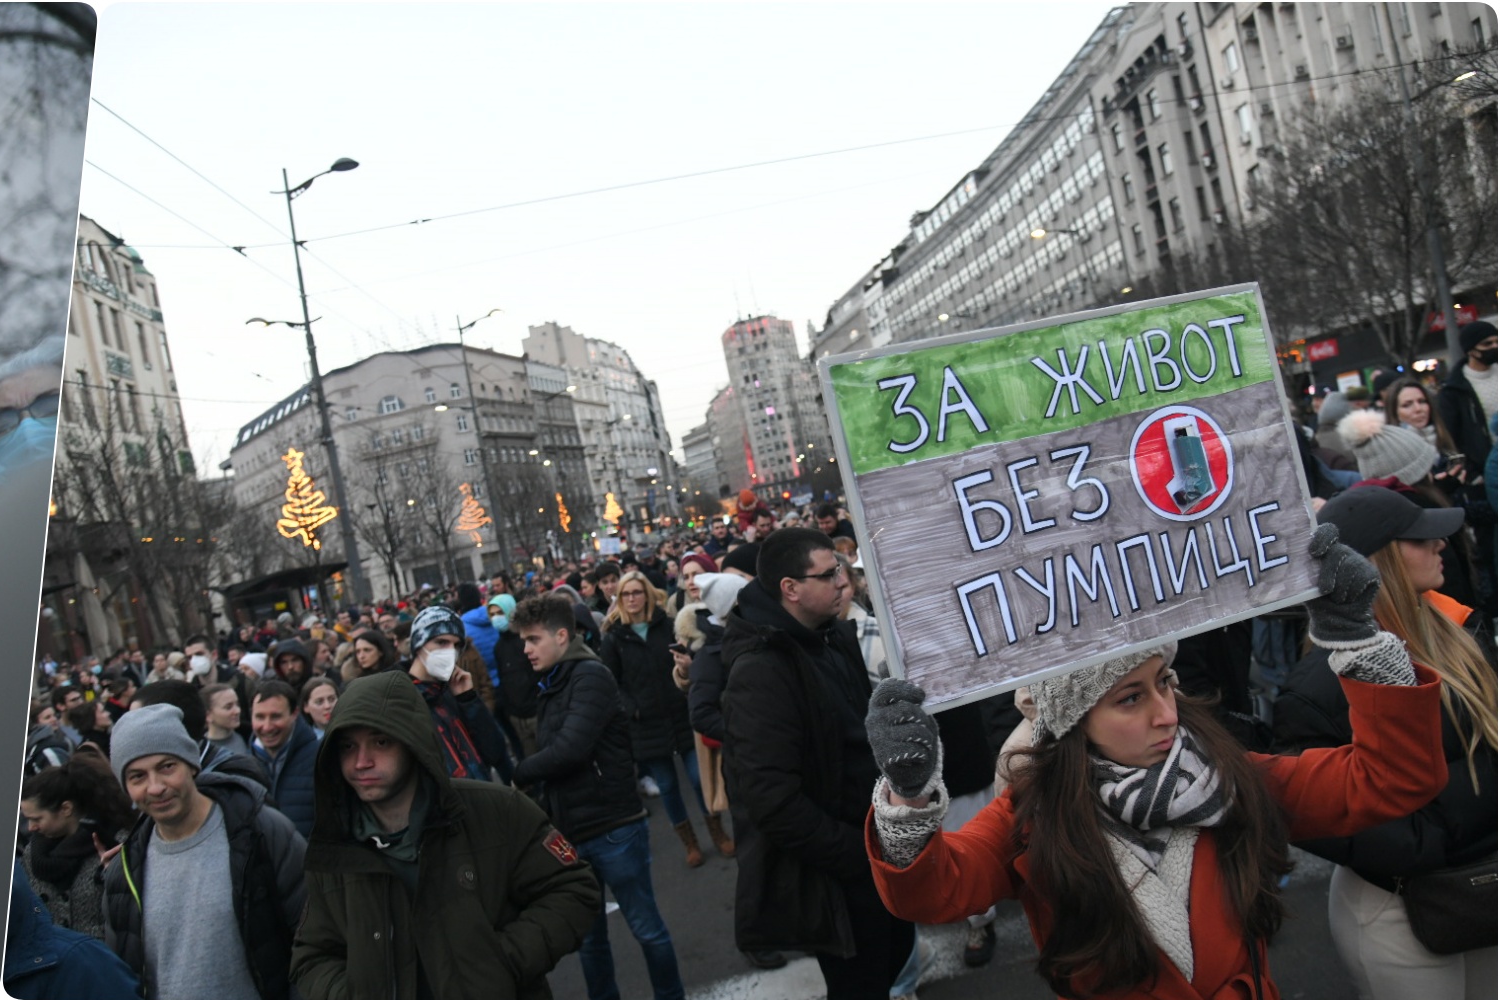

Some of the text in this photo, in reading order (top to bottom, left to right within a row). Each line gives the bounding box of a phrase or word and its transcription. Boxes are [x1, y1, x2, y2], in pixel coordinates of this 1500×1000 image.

[877, 314, 1246, 454] ЗА ЖИВОТ
[951, 443, 1110, 552] БЕЗ
[955, 501, 1288, 659] ПУМПИЦЕ
